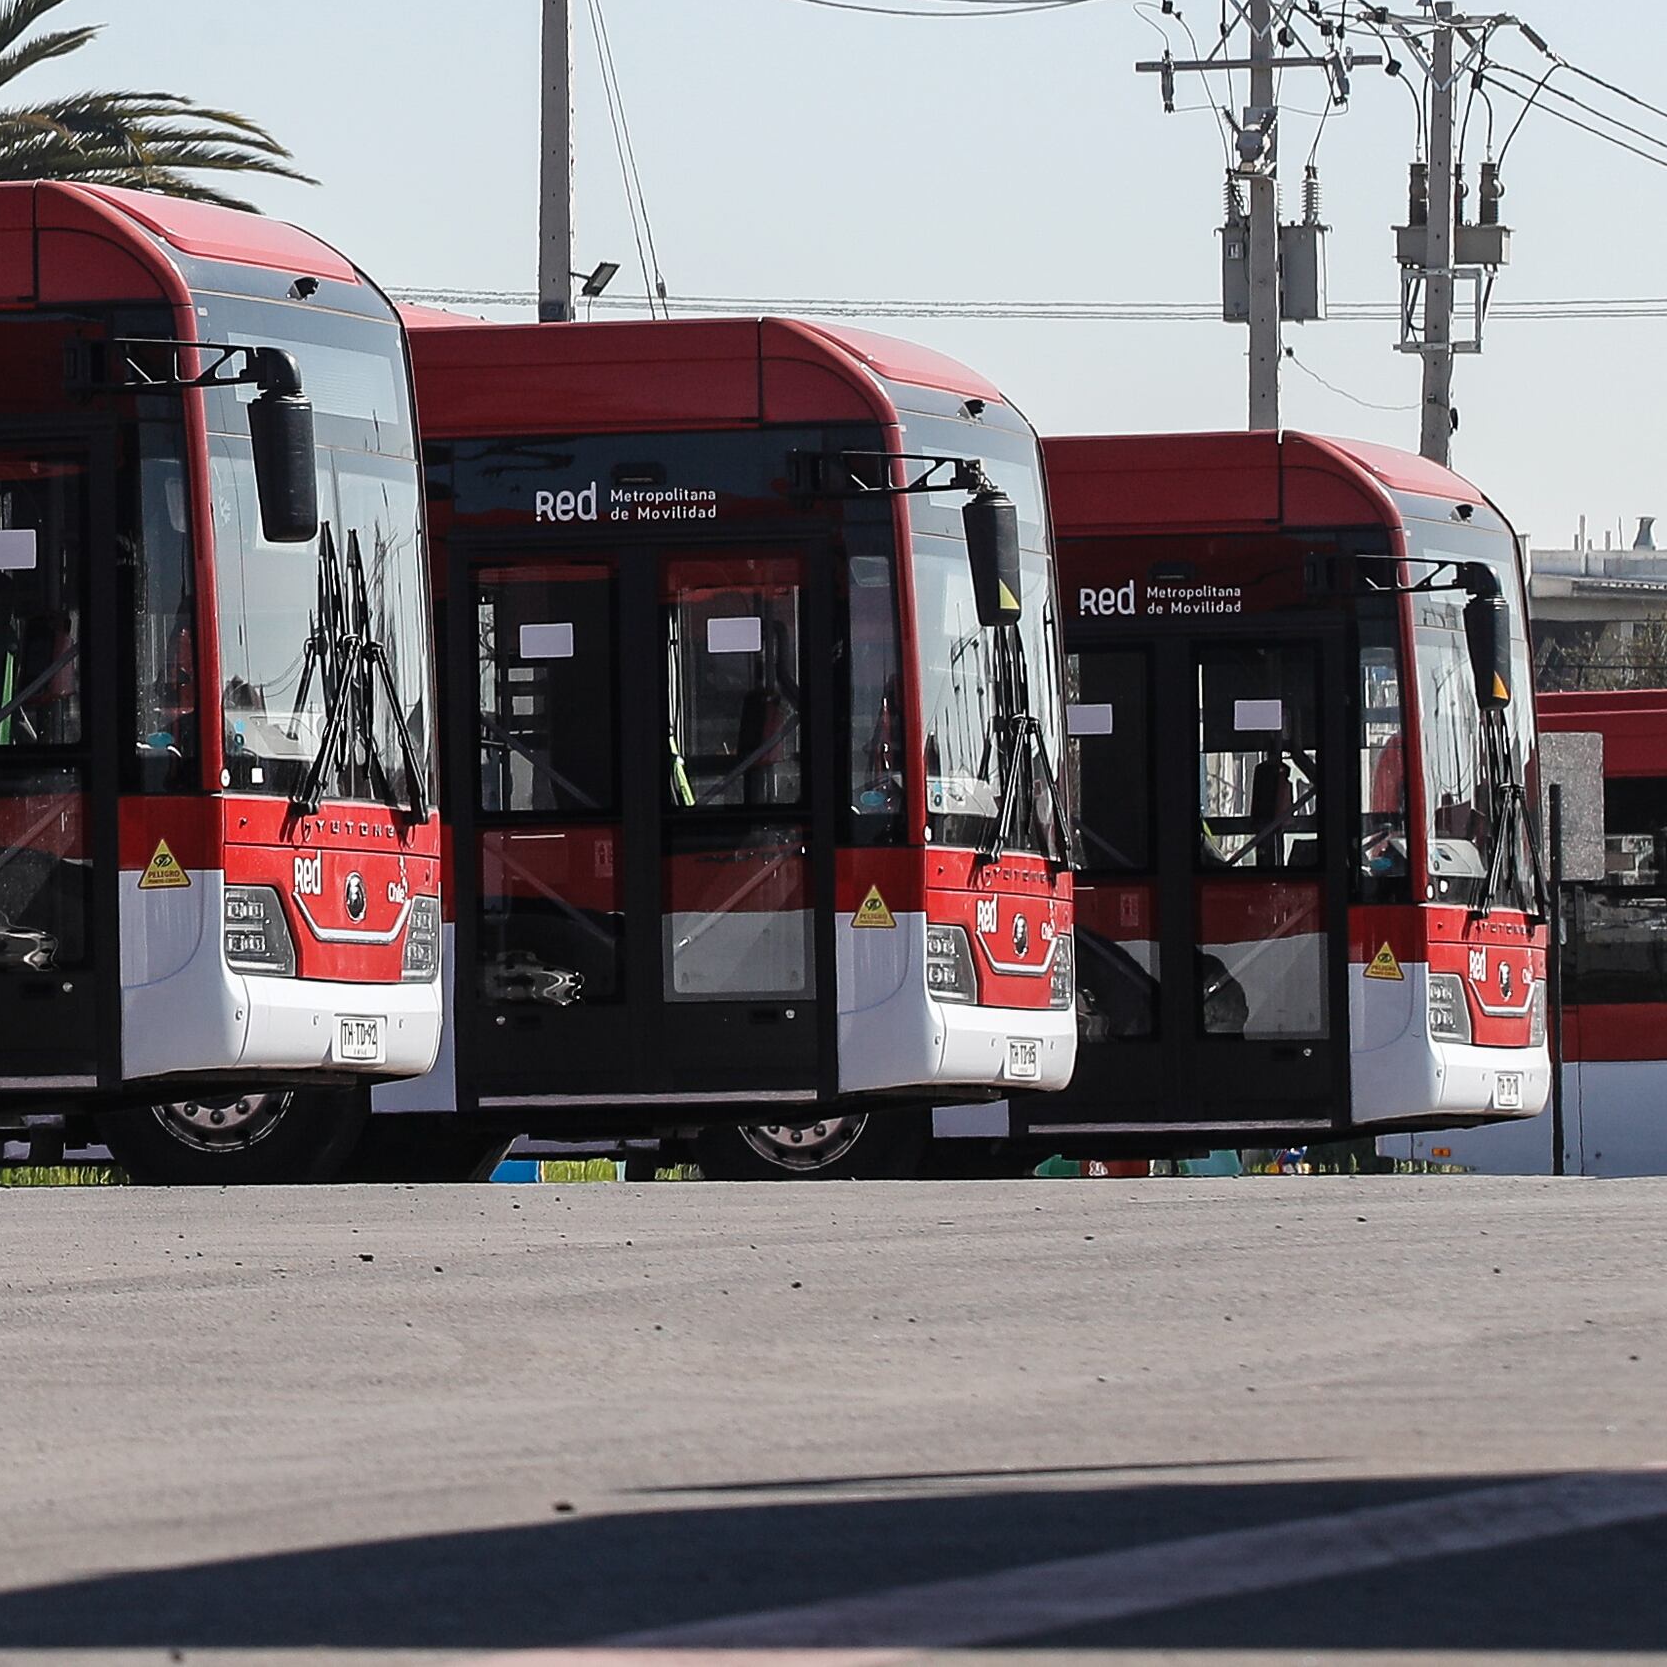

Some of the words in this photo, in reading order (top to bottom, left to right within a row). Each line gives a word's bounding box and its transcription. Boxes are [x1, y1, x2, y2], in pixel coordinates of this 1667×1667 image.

[535, 481, 597, 522] Red
[610, 488, 717, 504] Metropolitana
[610, 507, 630, 521] de
[637, 505, 717, 520] Movilidad
[1079, 579, 1136, 616] Red
[1146, 585, 1242, 600] Metropolitana
[1147, 602, 1164, 615] de
[1171, 601, 1242, 614] Movilidad
[294, 849, 322, 895] Red
